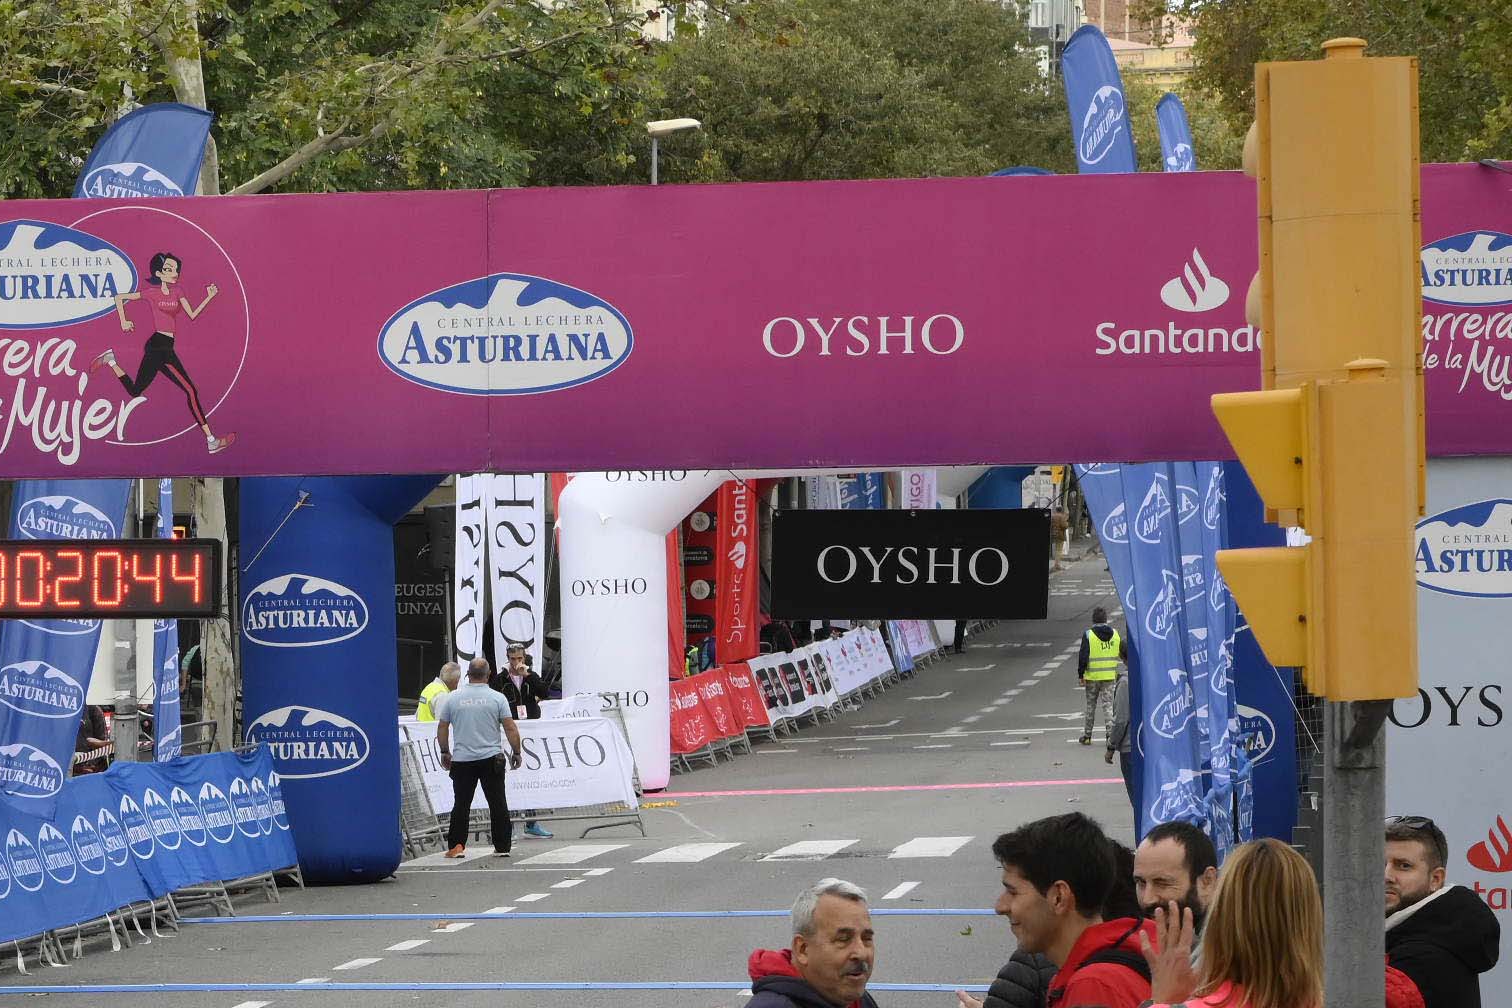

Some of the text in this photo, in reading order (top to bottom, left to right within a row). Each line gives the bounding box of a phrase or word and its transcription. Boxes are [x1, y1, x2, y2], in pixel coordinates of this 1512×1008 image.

[40, 256, 113, 268] LECHERA
[436, 313, 606, 329] CENTRAL LECHERA
[397, 320, 614, 366] ASTURIANA
[761, 313, 965, 359] OYSHO
[1094, 321, 1262, 356] Santand
[1445, 341, 1463, 369] la
[1442, 533, 1510, 545] CENTRAL
[815, 544, 1010, 587] OYSHO
[571, 577, 648, 597] OYSHO
[259, 598, 355, 608] CENTRAL LECHERA
[246, 603, 360, 631] ASTURIANA
[1388, 683, 1504, 729] OYS
[260, 729, 356, 739] CENTRAL LECHERA
[253, 737, 360, 760] TURIANA
